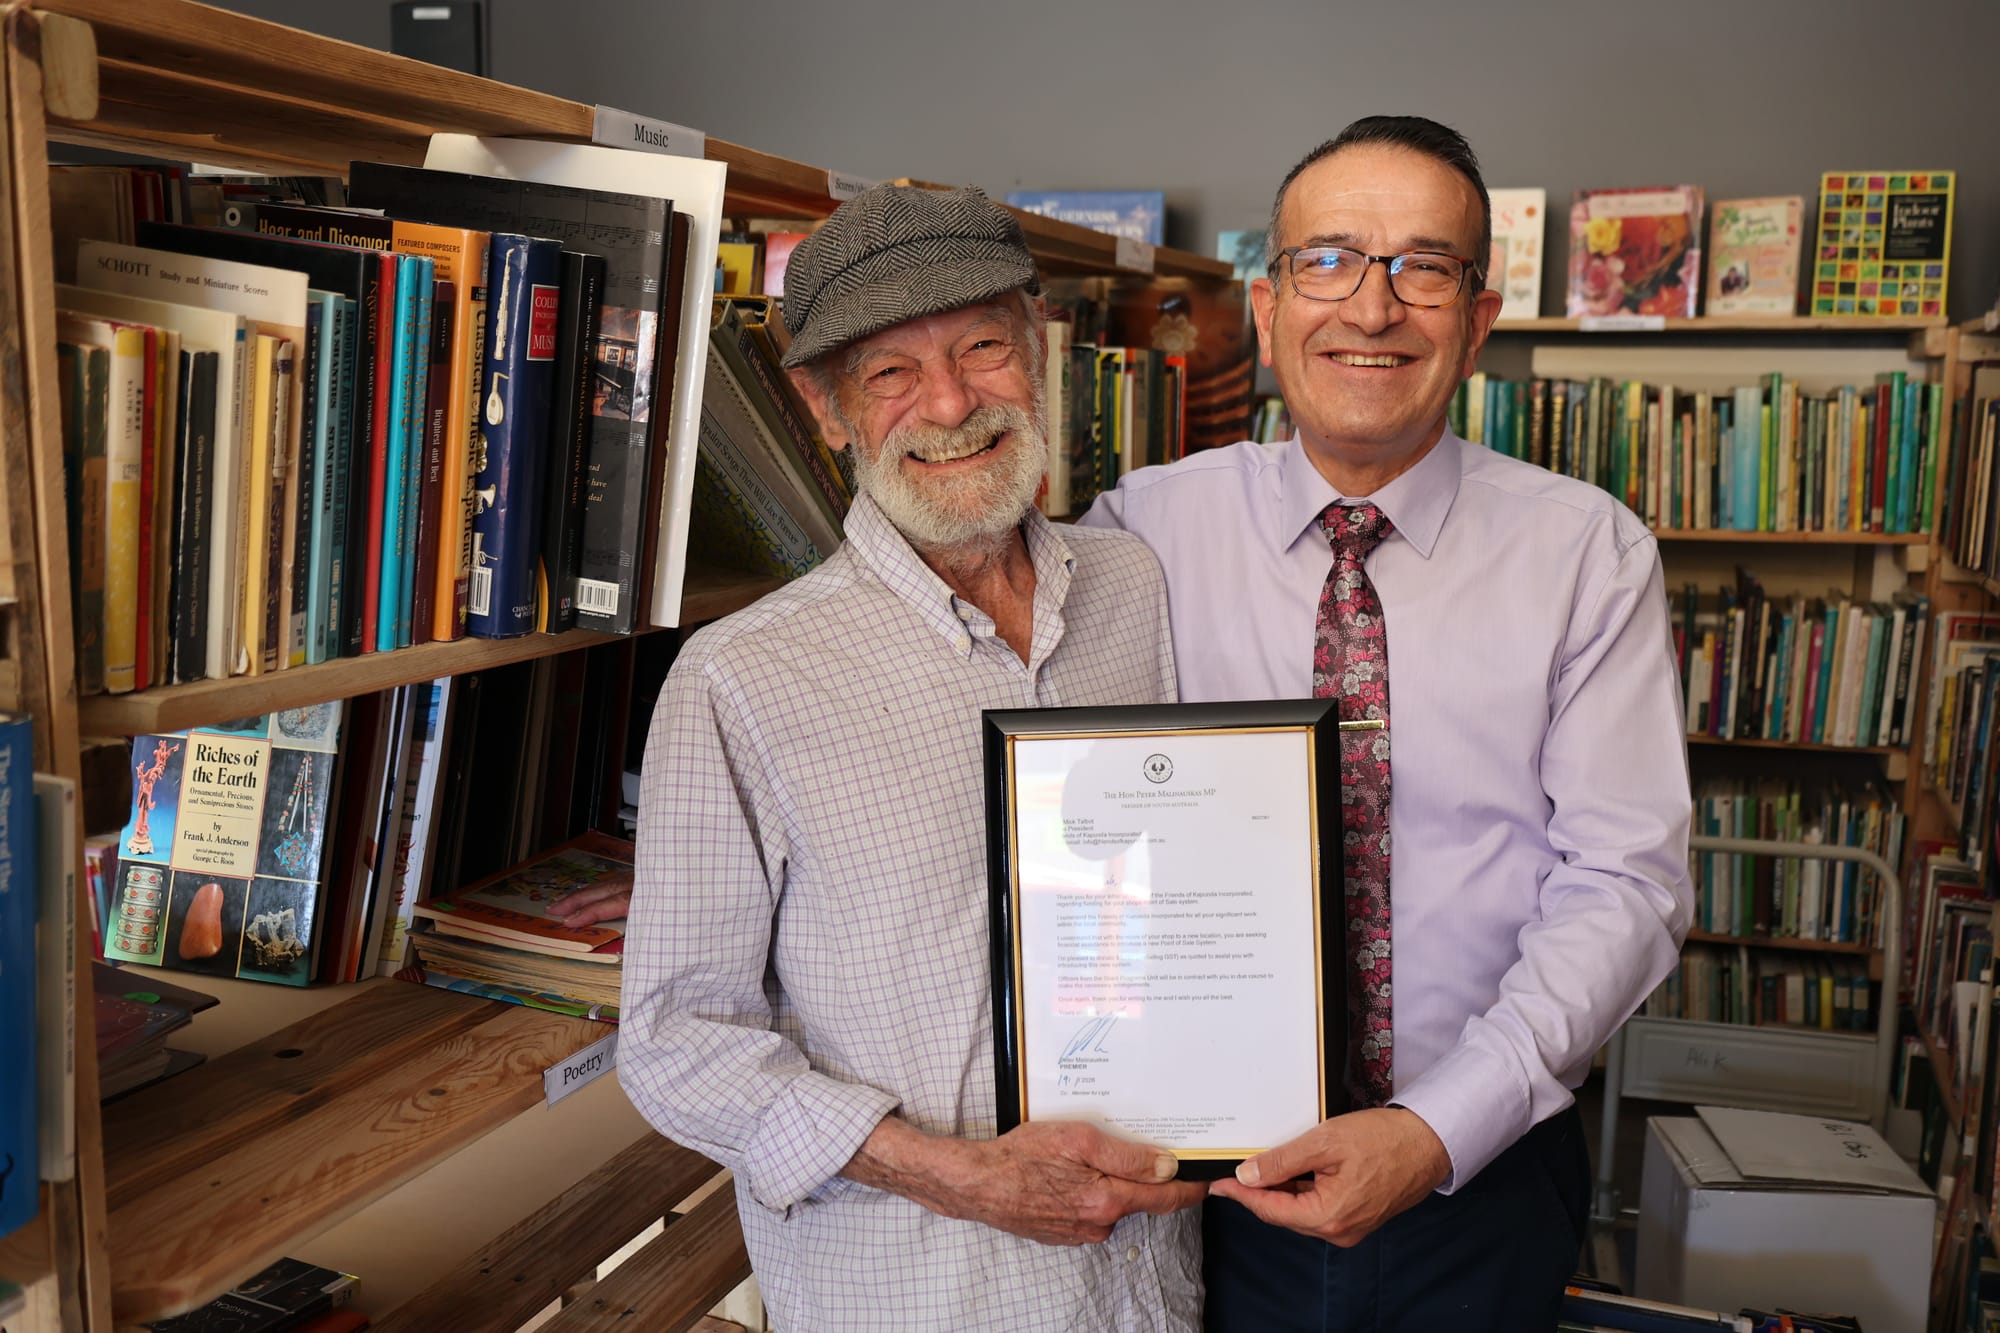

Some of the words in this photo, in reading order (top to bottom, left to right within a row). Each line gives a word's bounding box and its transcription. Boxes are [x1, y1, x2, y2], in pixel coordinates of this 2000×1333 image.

[634, 123, 669, 148] Music
[259, 218, 292, 237] Hear
[298, 226, 322, 241] and
[328, 227, 391, 250] Discover
[1892, 216, 1934, 230] Plants
[397, 238, 424, 249] FEATURED
[426, 241, 461, 253] COMPOSERS
[97, 256, 152, 277] SCHOTT
[160, 269, 181, 284] Study
[186, 275, 200, 285] and
[204, 277, 240, 291] Miniature
[243, 283, 269, 296] Scores
[333, 309, 343, 336] SEA
[472, 309, 487, 394] Classical
[329, 339, 340, 409] SHANTIES
[578, 354, 589, 419] AUSTRALIAN
[125, 380, 134, 412] RALPH
[124, 417, 133, 440] HILL
[338, 385, 350, 469] AUSTRALIAN
[365, 400, 373, 444] OSBORNE
[432, 408, 444, 446] Brightest
[469, 401, 481, 465] Music
[195, 434, 205, 471] Gilbert
[304, 420, 313, 470] THREE
[327, 424, 336, 460] STAN
[431, 447, 441, 464] and
[574, 422, 583, 472] COUNTRY
[429, 465, 439, 483] Best
[784, 411, 812, 463] MUSICAL
[812, 459, 844, 517] MEMORIES
[194, 474, 203, 494] and
[324, 463, 333, 515] HUGILL
[571, 475, 580, 505] MUSIC
[700, 418, 724, 451] opular
[720, 445, 739, 472] Songs
[738, 467, 754, 489] That
[752, 485, 766, 505] Will
[764, 500, 778, 520] Live
[777, 518, 799, 546] Forever
[302, 481, 310, 521] LEGS
[193, 496, 203, 539] Sullivan
[462, 475, 475, 569] Experience
[191, 545, 200, 567] The
[189, 569, 200, 598] Savoy
[332, 559, 341, 585] LONG
[331, 587, 339, 595] &
[188, 600, 198, 638] Operas
[329, 596, 338, 633] JENKIN
[195, 743, 241, 766] Riches
[243, 750, 260, 767] of
[192, 765, 213, 784] the
[217, 767, 257, 789] Earth
[188, 797, 199, 805] and
[199, 798, 235, 809] Semiprecious
[235, 802, 254, 811] Stones
[189, 786, 226, 799] Ornamental,
[227, 790, 255, 802] Precious,
[1103, 791, 1117, 800] THE
[1118, 791, 1135, 799] HON
[1136, 790, 1156, 799] PETER
[1157, 788, 1202, 798] MALINAUSKAS
[1203, 788, 1217, 797] MP
[183, 830, 205, 842] Frank
[206, 832, 213, 843] J.
[214, 834, 250, 848] Anderson
[213, 821, 222, 832] by
[1083, 831, 1107, 839] Kapunda
[192, 854, 211, 864] George
[212, 855, 219, 864] C.
[220, 857, 235, 866] Roos
[1193, 890, 1217, 899] Kapunda
[1162, 933, 1175, 941] shop
[1245, 931, 1267, 939] seeking
[563, 1052, 604, 1086] Poetry
[1075, 1056, 1109, 1064] Malinauskas
